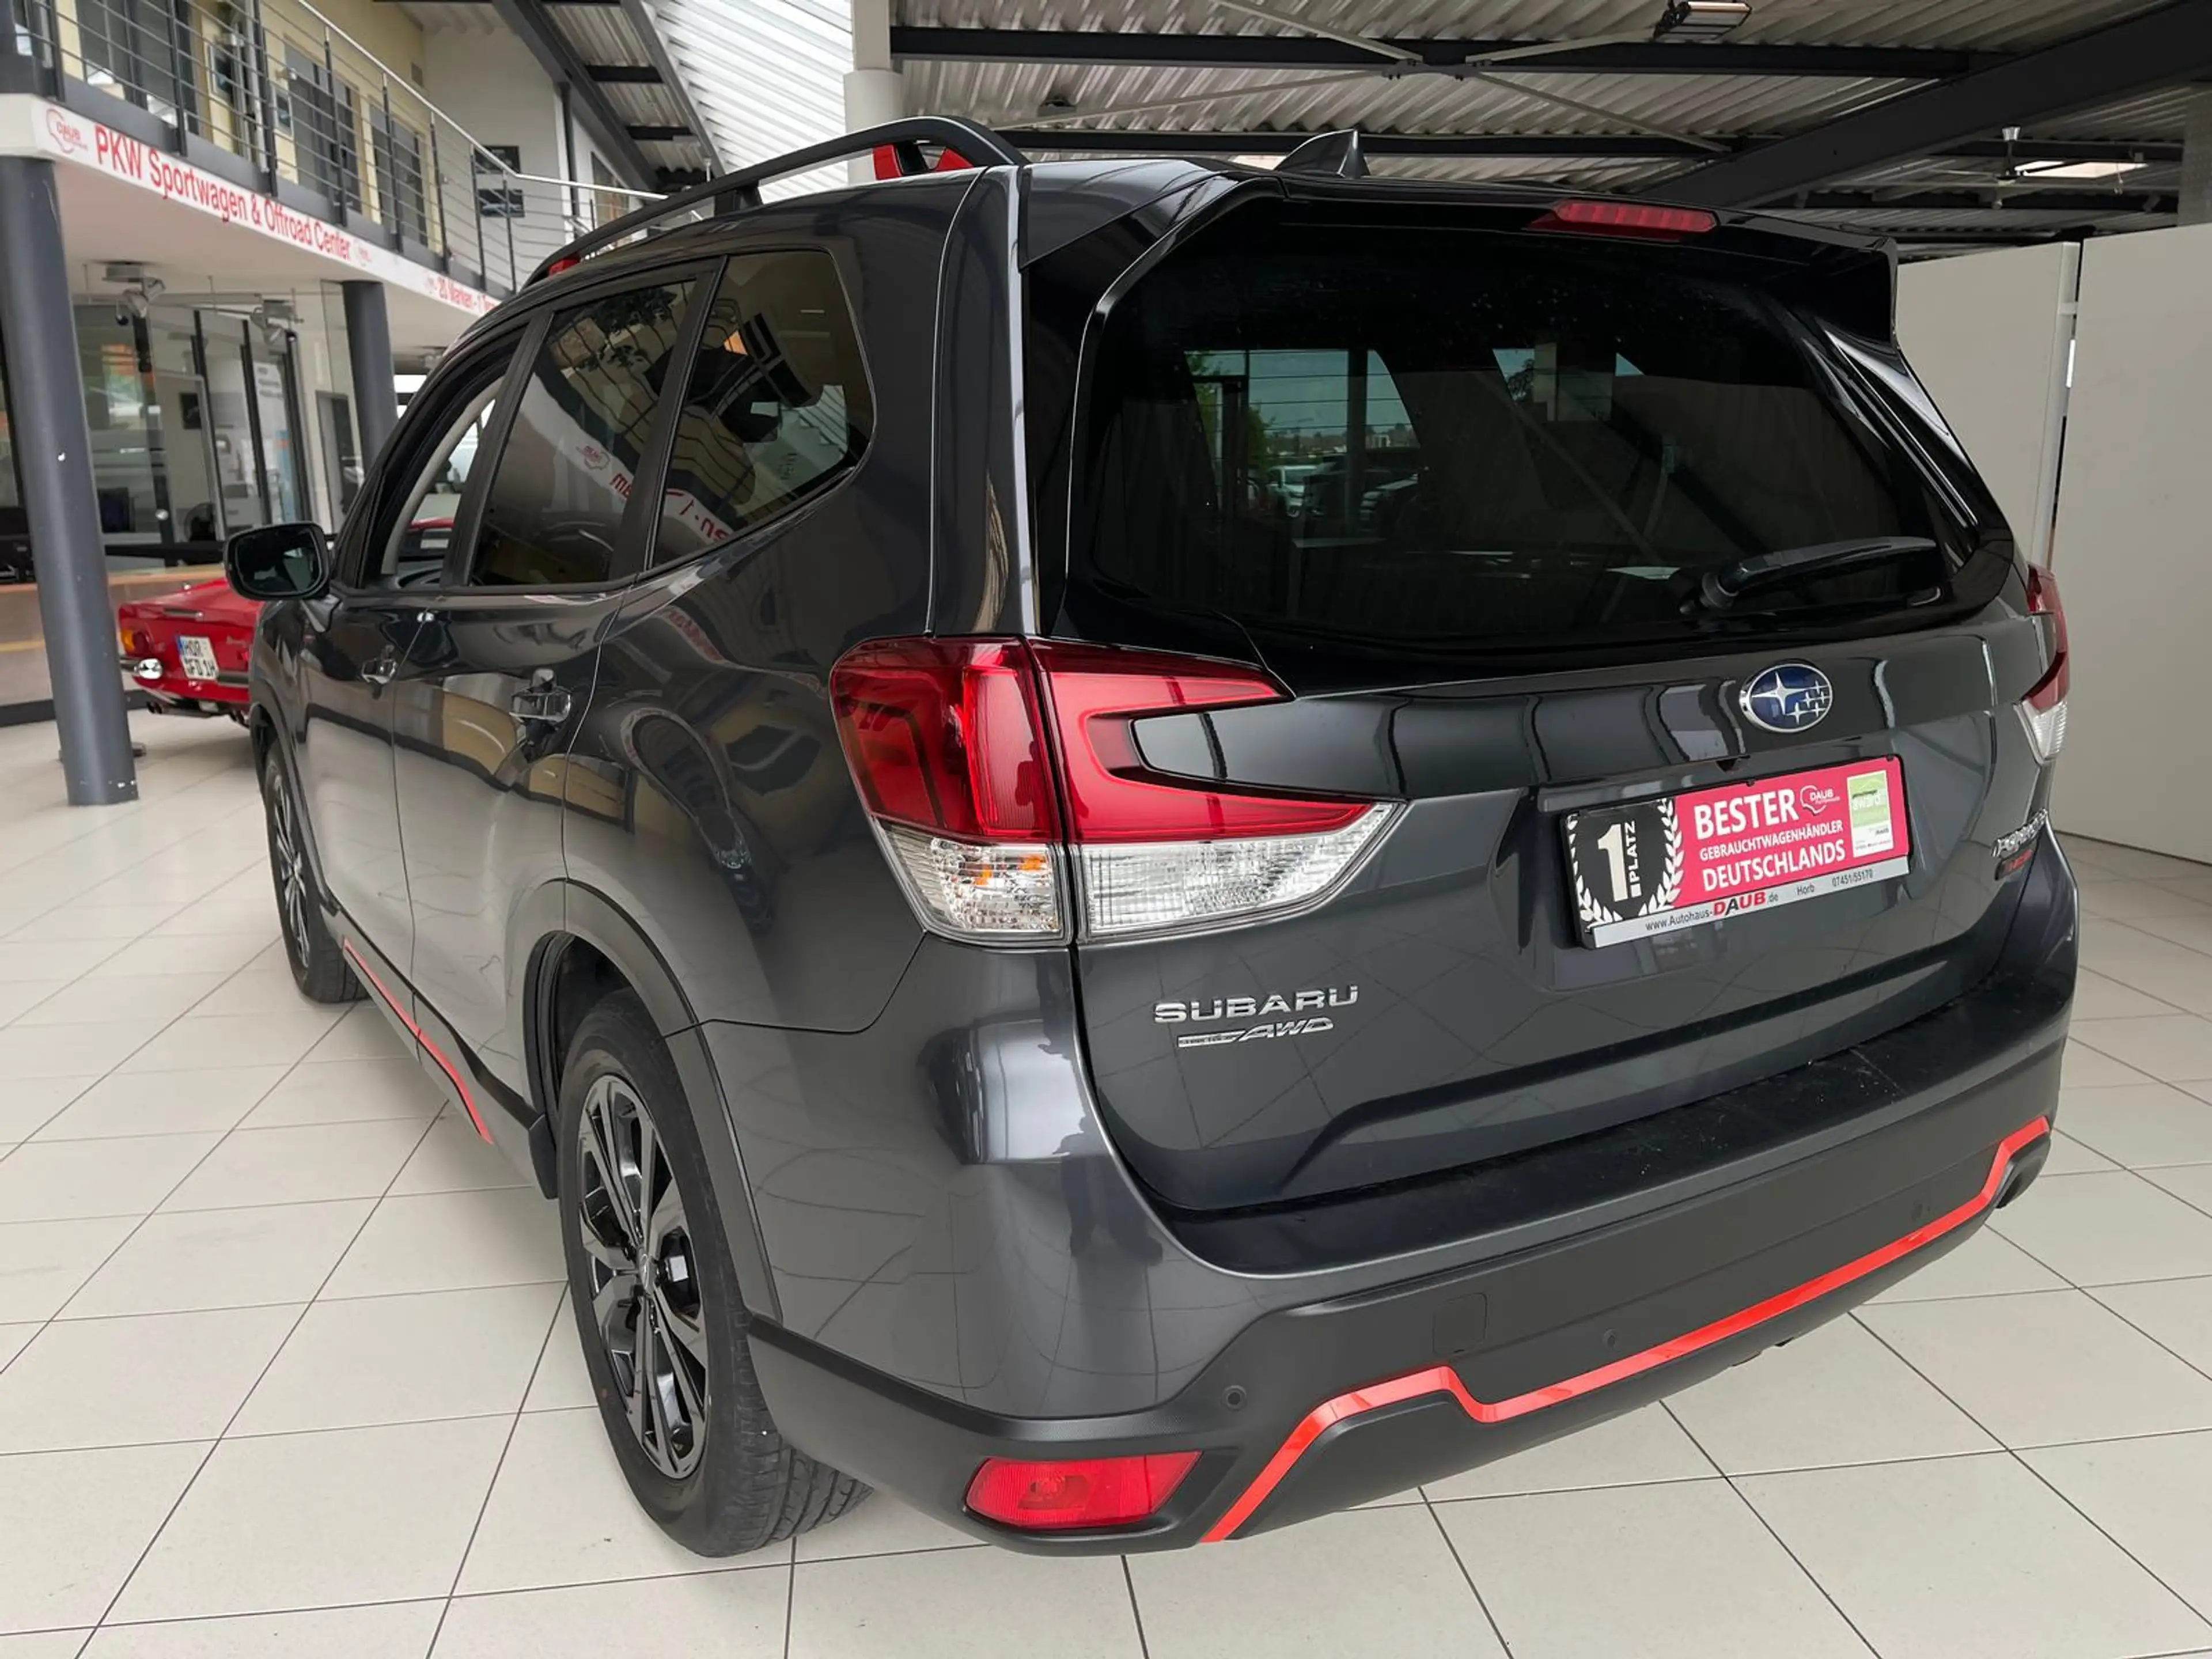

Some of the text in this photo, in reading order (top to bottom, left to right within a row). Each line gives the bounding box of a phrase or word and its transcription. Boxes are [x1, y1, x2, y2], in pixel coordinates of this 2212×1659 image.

[94, 124, 142, 180] PKW
[149, 147, 248, 222] Sportwagen
[251, 194, 262, 226] &
[264, 198, 312, 245] Offroad
[314, 221, 350, 260] Center
[1694, 788, 1800, 840] BESTER
[1809, 788, 1834, 801] DAUB
[1624, 820, 1640, 883] PLATZ
[1700, 820, 1843, 862] GEBRAUCHTWAGENHÄNDLER
[1702, 839, 1846, 892] DEUTSCHLANDS
[1797, 882, 1815, 896] Horb
[1154, 985, 1359, 1024] SUBARU
[1238, 1016, 1334, 1042] AWD
